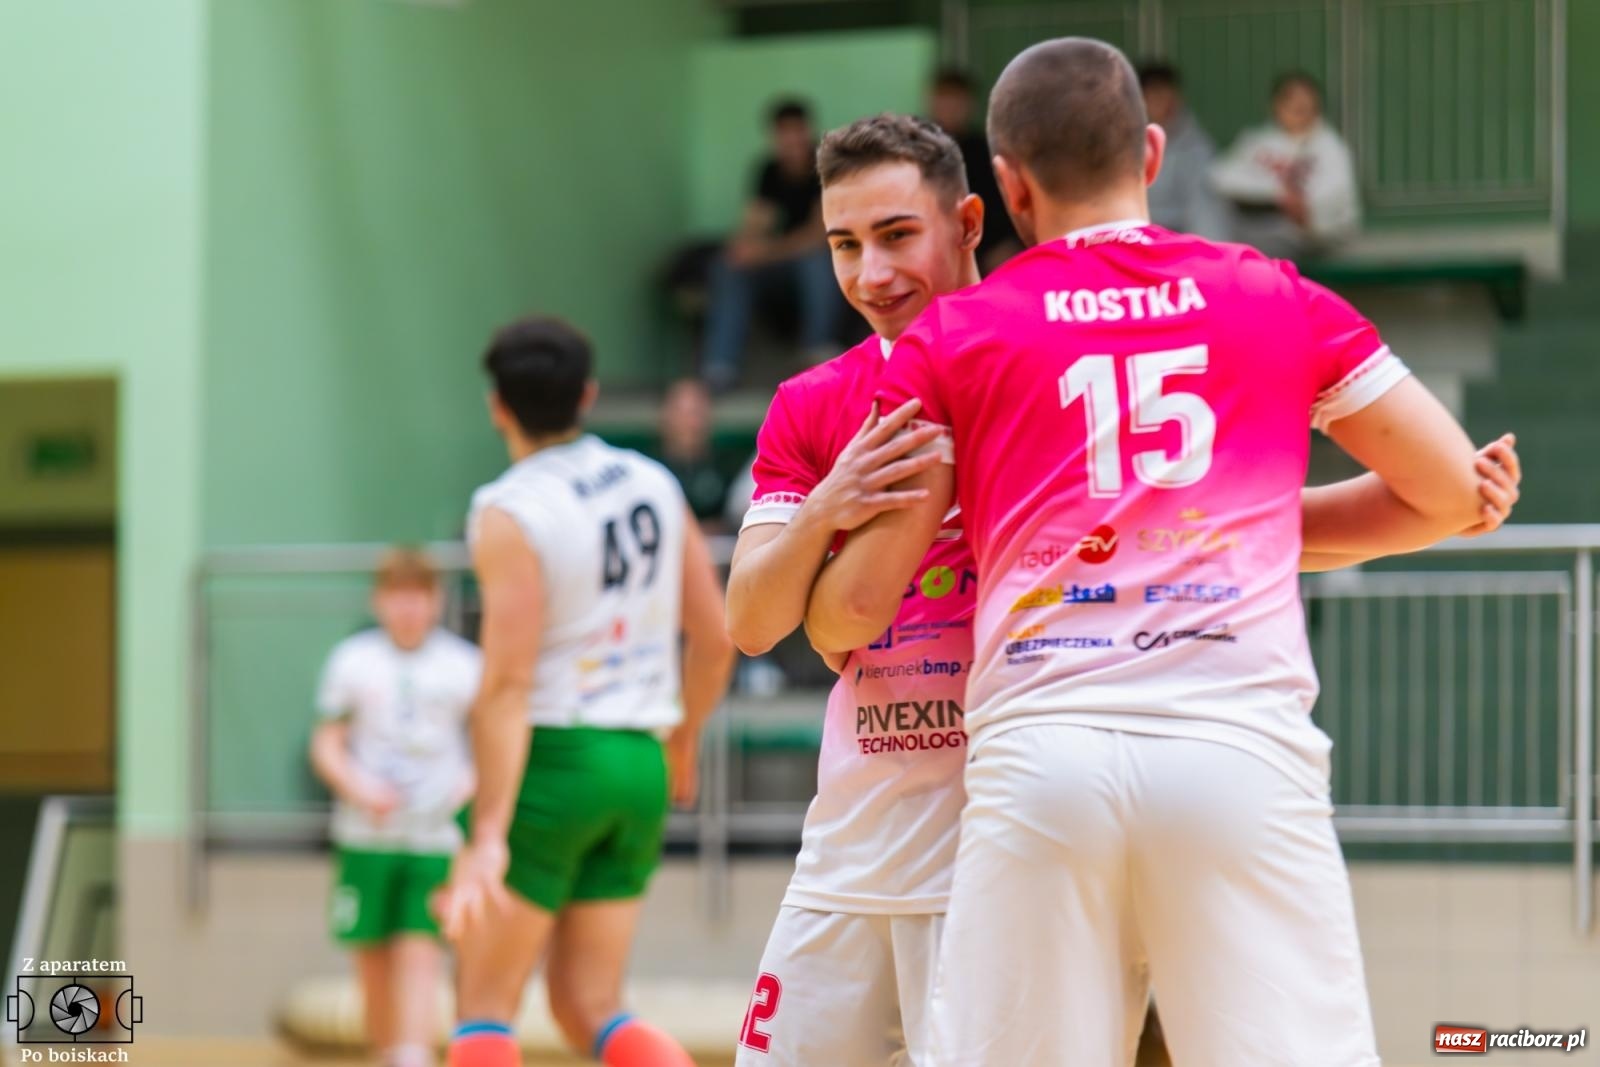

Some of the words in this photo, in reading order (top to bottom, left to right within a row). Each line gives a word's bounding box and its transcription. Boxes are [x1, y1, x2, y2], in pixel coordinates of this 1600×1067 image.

[1043, 277, 1207, 322] KOSTKA
[1058, 344, 1216, 499] 15
[601, 502, 662, 591] 49
[856, 699, 965, 734] PIVEXIN
[858, 730, 969, 755] TECHNOLOGY
